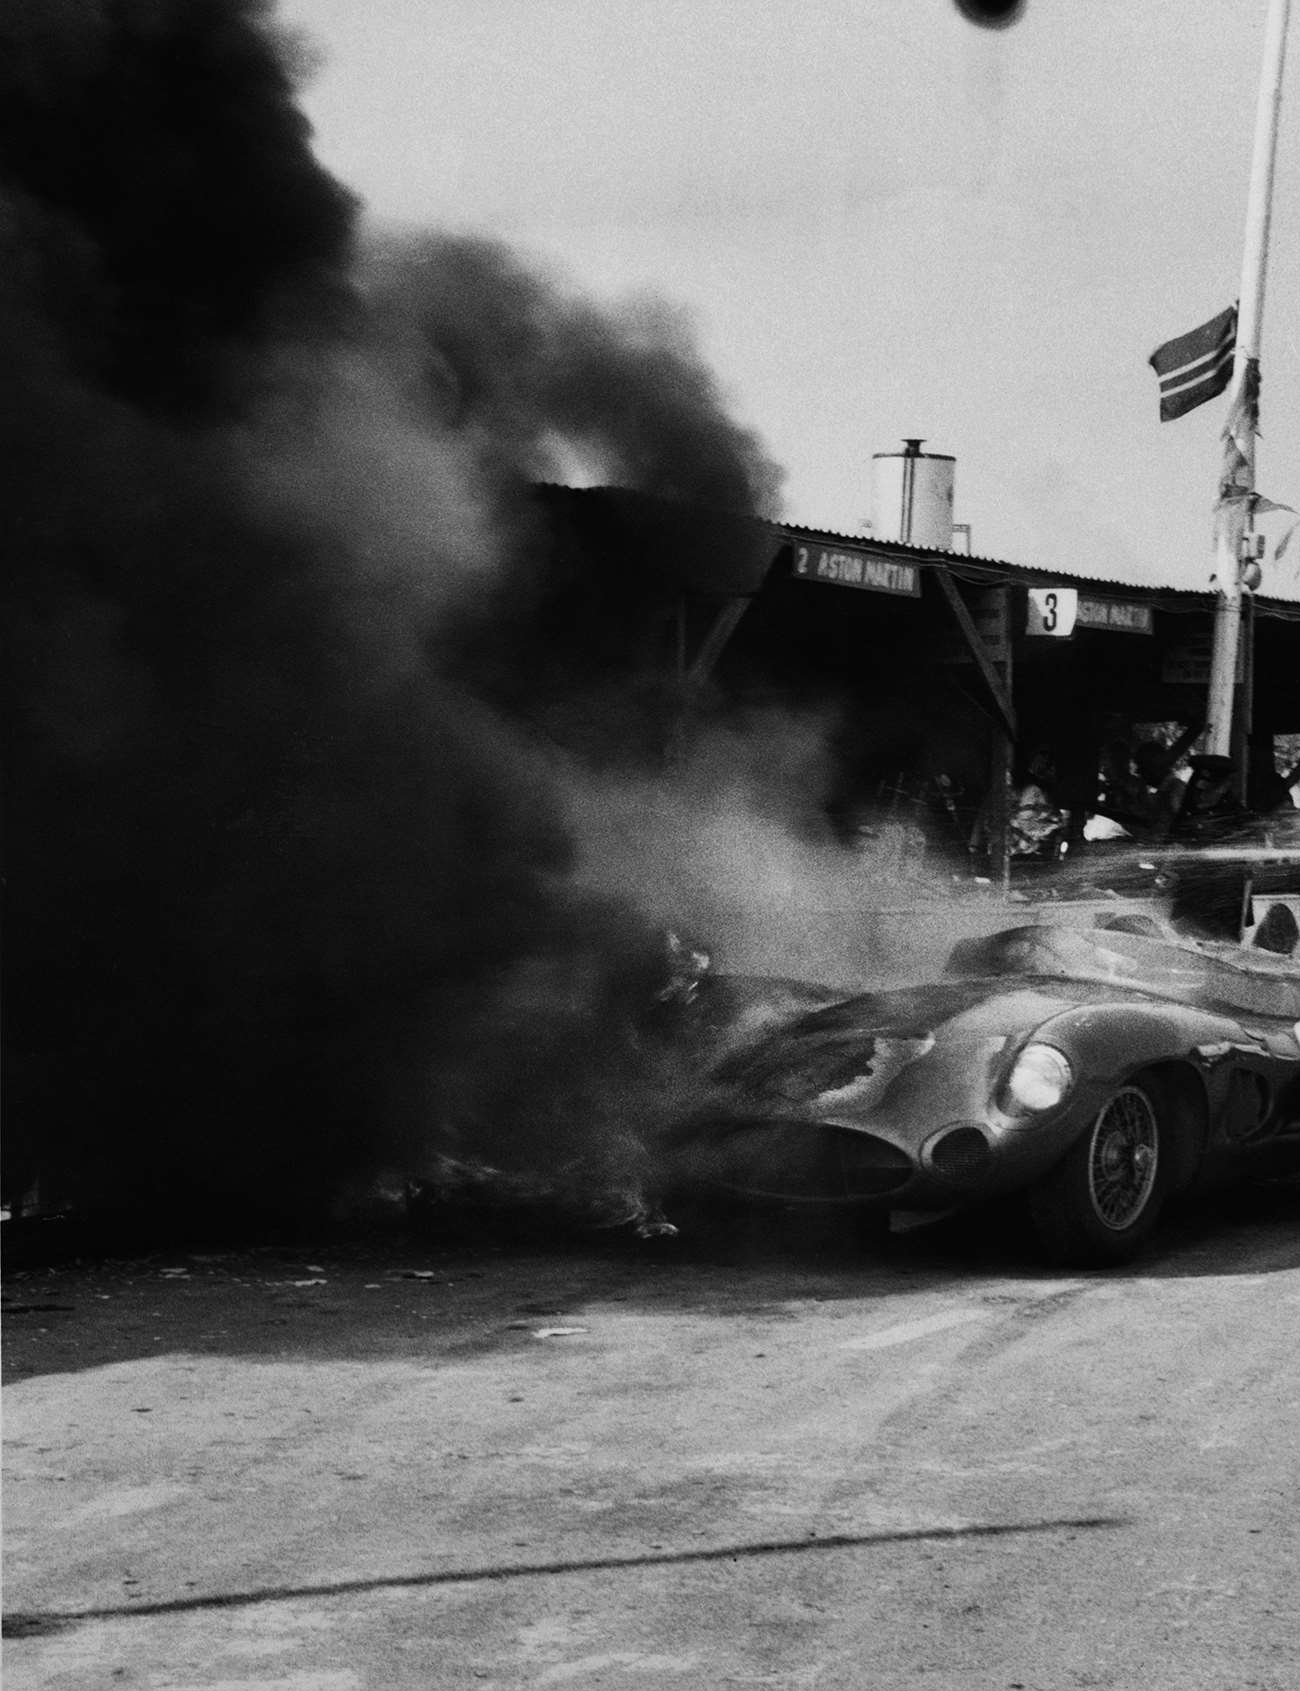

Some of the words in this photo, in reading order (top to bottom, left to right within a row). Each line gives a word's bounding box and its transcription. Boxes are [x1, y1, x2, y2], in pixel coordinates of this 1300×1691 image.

[797, 546, 808, 574] 2
[817, 551, 863, 583] ASTON
[864, 560, 914, 592] MARTIN
[1042, 592, 1057, 632] 3
